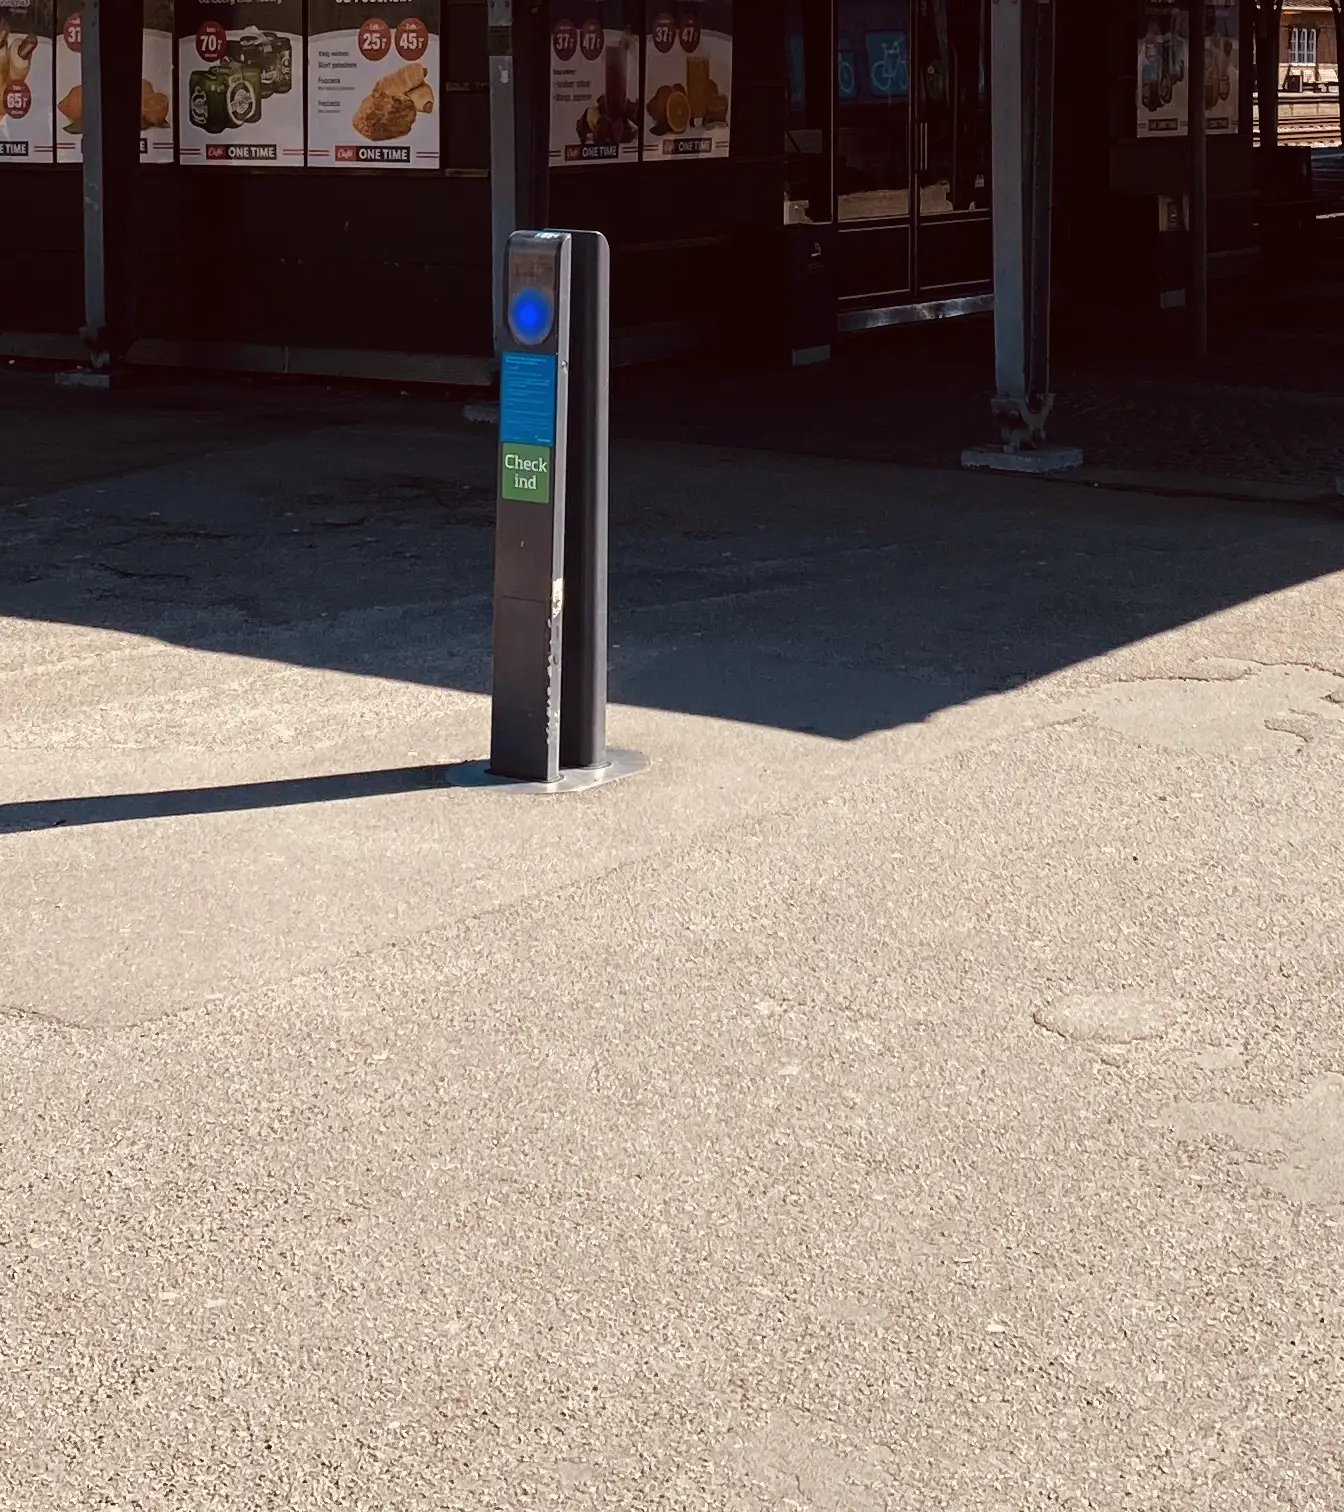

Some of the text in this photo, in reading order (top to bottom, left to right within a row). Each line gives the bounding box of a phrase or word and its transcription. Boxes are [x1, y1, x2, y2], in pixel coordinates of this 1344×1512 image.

[5, 142, 27, 155] TIME
[228, 147, 250, 159] ONE
[251, 146, 275, 158] TIME
[359, 148, 381, 160] ONE
[382, 147, 408, 160] TIME
[582, 146, 599, 157] ONE
[504, 453, 548, 473] Check
[514, 473, 537, 491] ind
